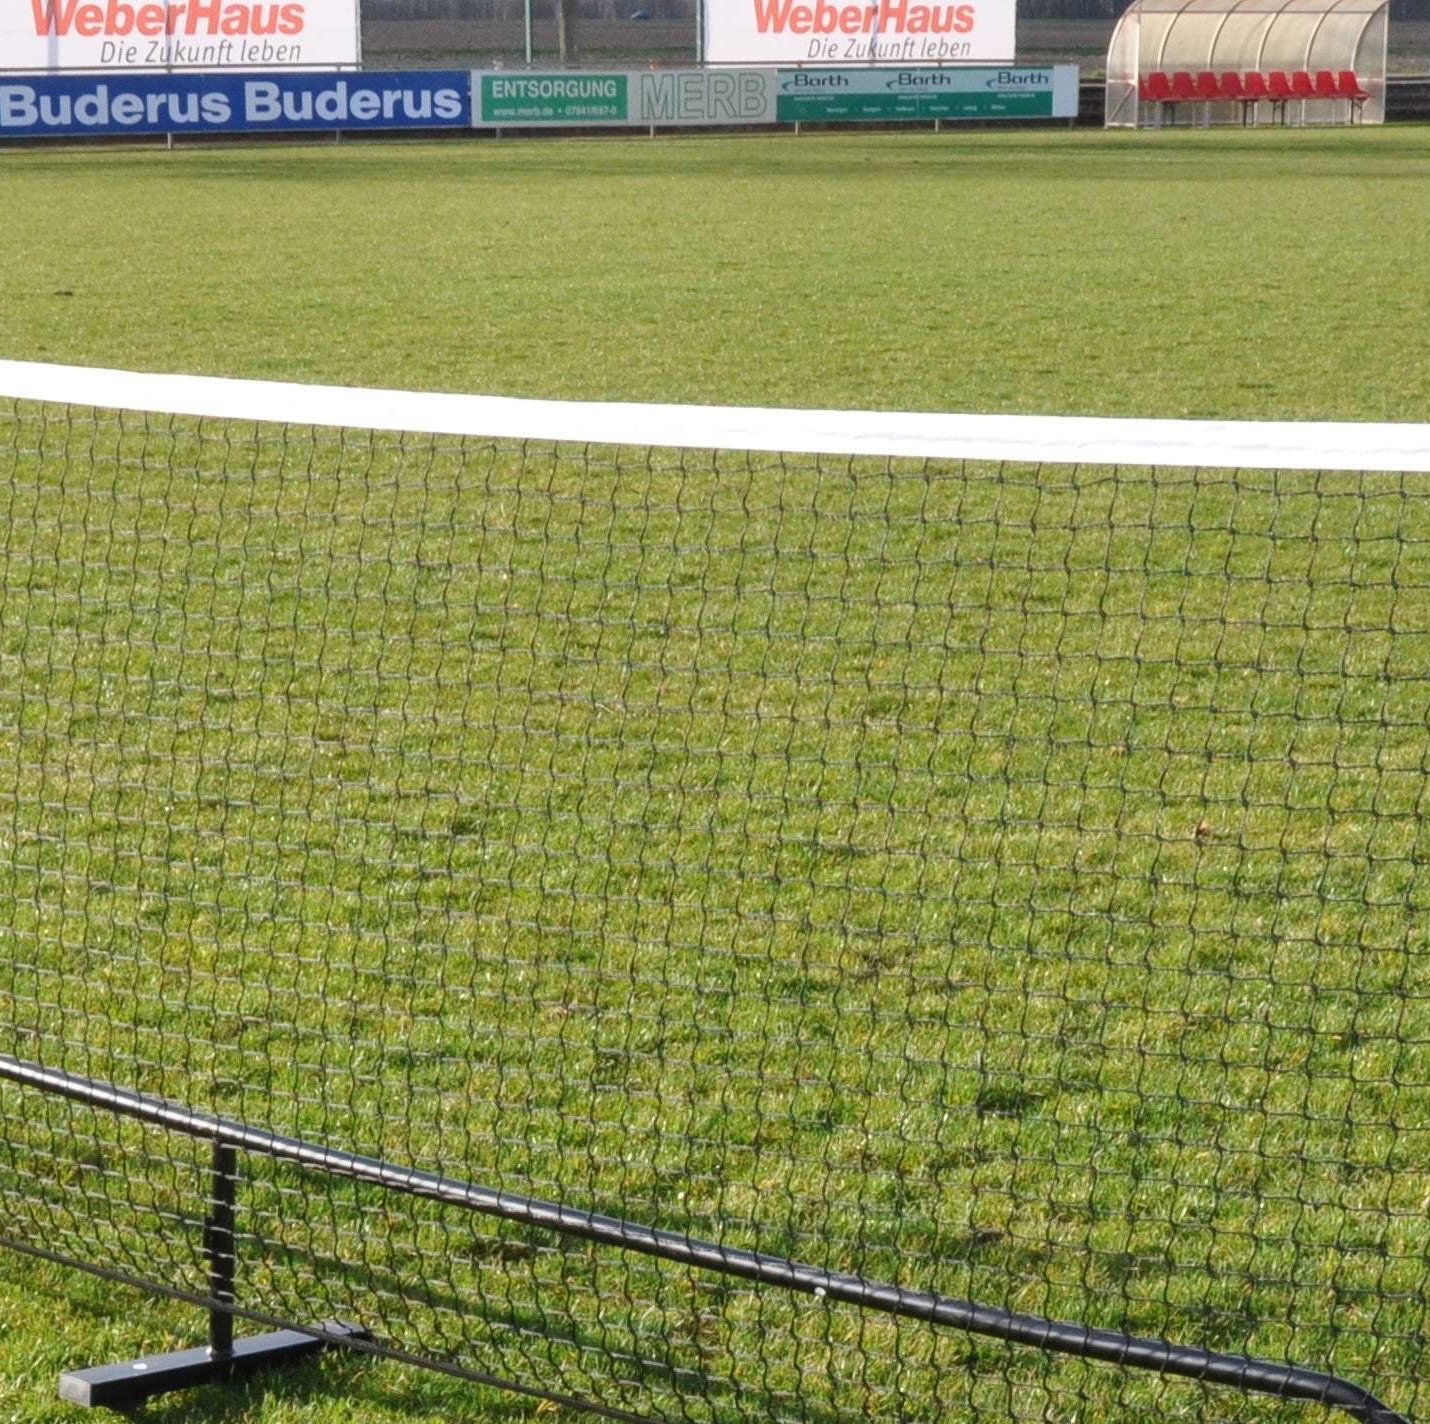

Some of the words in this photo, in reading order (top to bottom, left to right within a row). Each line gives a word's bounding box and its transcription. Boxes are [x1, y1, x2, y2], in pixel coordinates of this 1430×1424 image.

[30, 0, 305, 36] WeberHaus
[753, 0, 975, 34] WeberHaus
[100, 41, 137, 63] Die
[145, 39, 233, 65] Zukunft
[240, 39, 301, 62] leben
[807, 38, 838, 58] Die
[844, 38, 915, 60] Zukunft
[921, 37, 971, 58] leben
[492, 80, 617, 98] ENTSORGUNG
[794, 74, 849, 87] Barth
[898, 73, 951, 86] Barth
[997, 71, 1049, 84] Barth
[244, 81, 462, 121] Buderus
[640, 72, 768, 120] MERB
